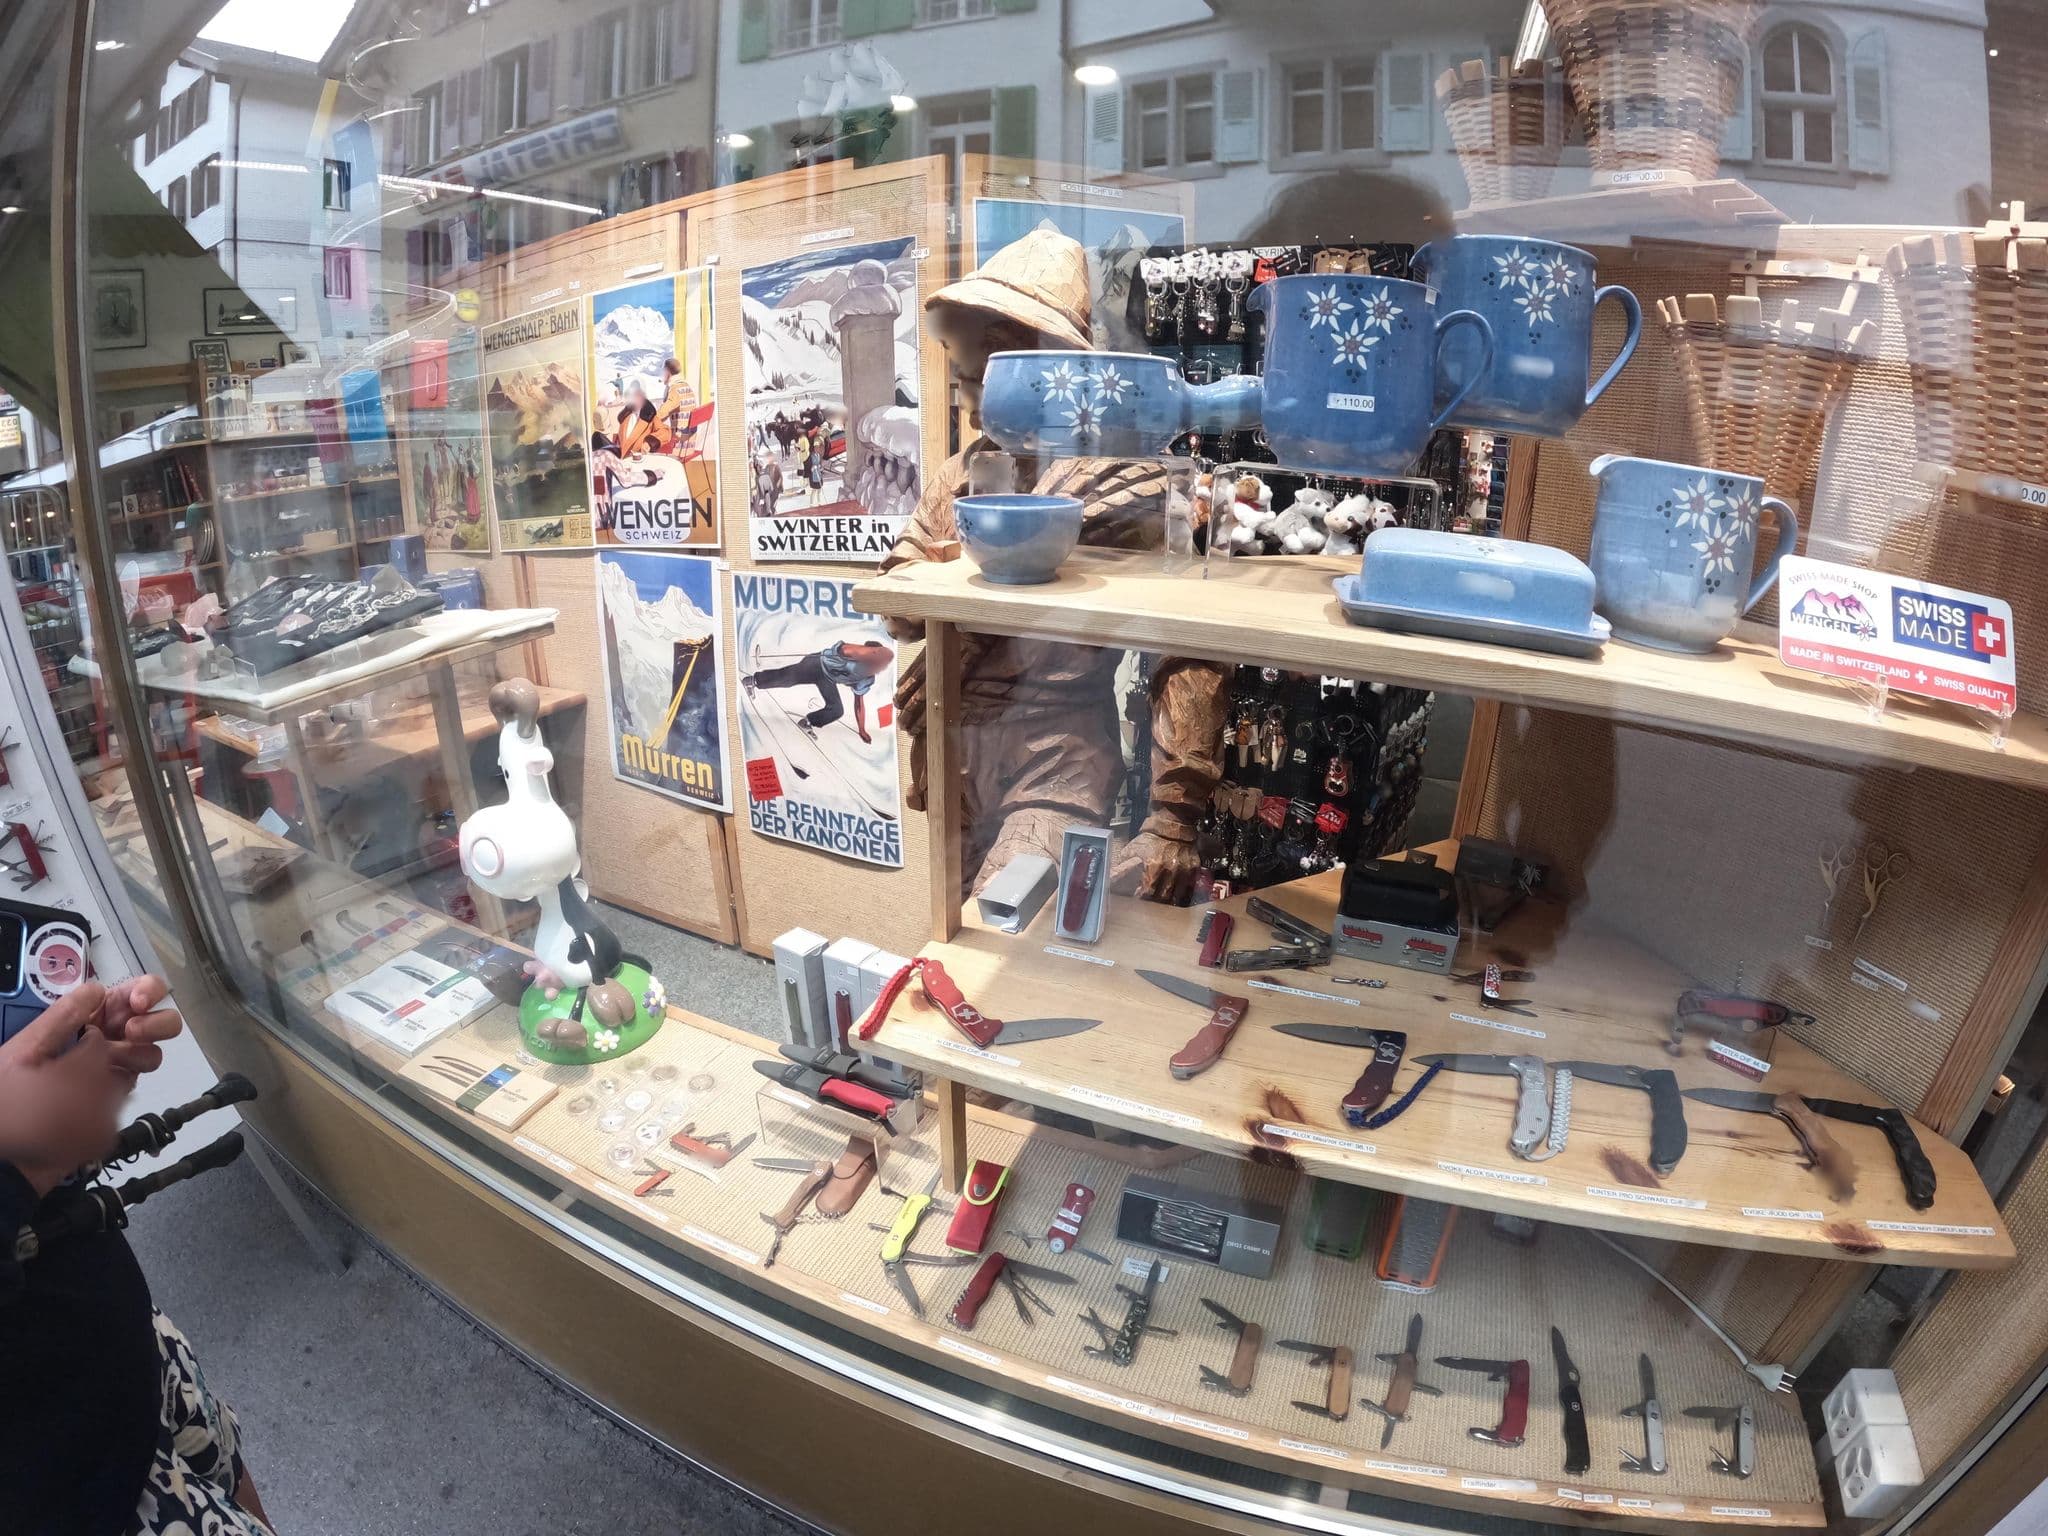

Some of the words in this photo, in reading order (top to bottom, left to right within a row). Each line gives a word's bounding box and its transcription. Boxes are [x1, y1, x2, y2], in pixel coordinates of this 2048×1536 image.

[1613, 172, 1632, 182] CHF
[484, 319, 544, 352] WENGERNALP
[550, 308, 579, 334] BAHN
[597, 497, 712, 530] WENGEN
[774, 517, 863, 534] WINTER
[871, 519, 890, 534] in
[625, 531, 682, 541] SCHWEIZ
[758, 534, 896, 553] SWITZERLAN
[734, 575, 879, 620] MÜRRE
[1788, 572, 1817, 586] SWISS
[1819, 571, 1849, 586] MADE
[1852, 581, 1879, 600] SHOP
[1791, 612, 1852, 633] WENGEN
[1899, 595, 1967, 627] SWISS
[1900, 617, 1968, 650] MADE
[1790, 646, 1822, 661] MADE
[1823, 652, 1834, 663] IN
[1836, 655, 1911, 680] SWITZERLAND
[1933, 676, 1966, 693] SWISS
[1967, 684, 2009, 701] QUALITY
[750, 799, 778, 816] DIE
[786, 800, 899, 844] RENNTAGE
[751, 810, 787, 838] DER
[792, 819, 900, 864] KANONEN
[1292, 1131, 1311, 1140] ALOX
[1465, 1168, 1484, 1176] ALOX
[1485, 1171, 1511, 1180] SILVER
[1588, 1188, 1617, 1198] HUNTER
[1619, 1191, 1633, 1200] PRO
[1635, 1193, 1669, 1204] SCHWARZ
